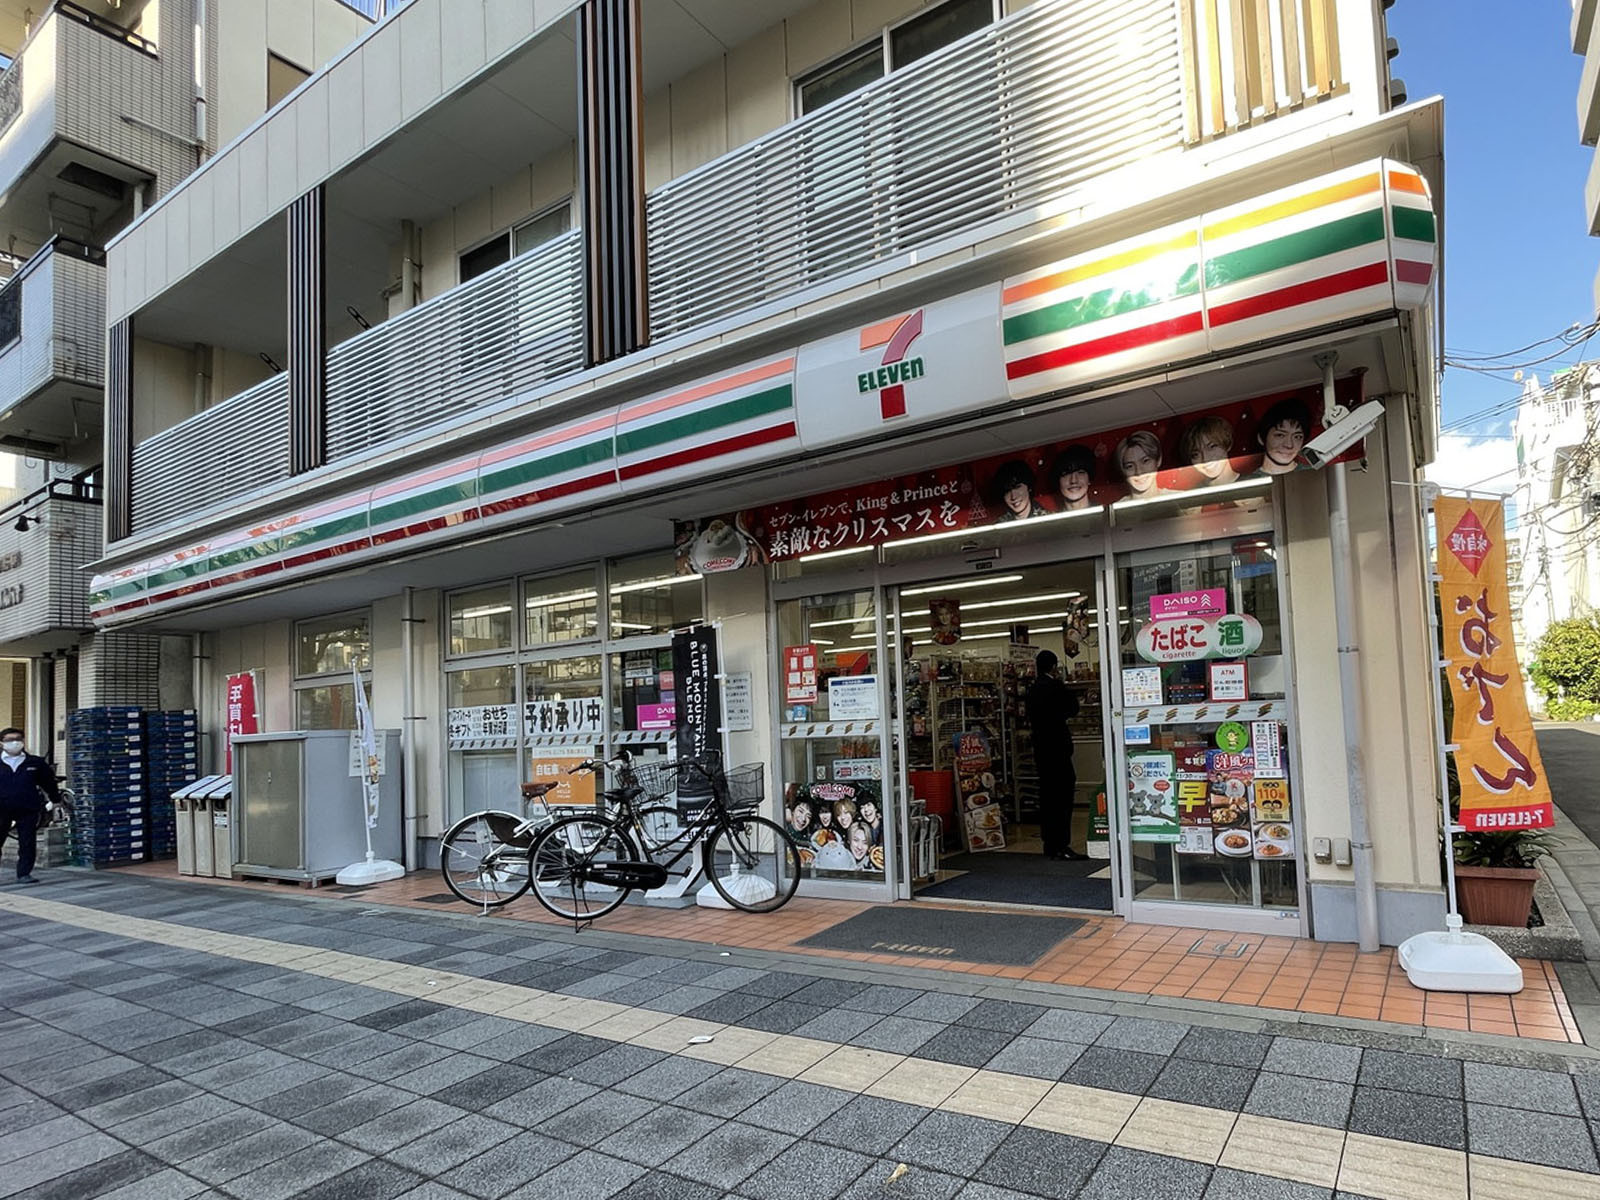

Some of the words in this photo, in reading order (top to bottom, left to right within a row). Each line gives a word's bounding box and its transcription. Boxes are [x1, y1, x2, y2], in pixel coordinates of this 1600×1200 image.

[856, 495, 888, 512] King
[890, 492, 900, 505] &
[769, 500, 961, 558] 素敵なクリスマスを
[1163, 595, 1198, 606] DAISO
[1150, 624, 1207, 652] たばこ
[1218, 620, 1244, 646] 酒
[690, 641, 700, 677] BLUE
[1162, 650, 1196, 659] cigarette
[1222, 647, 1246, 655] liquor
[1220, 668, 1236, 677] ATM
[686, 676, 694, 724] BLEND
[482, 706, 509, 721] おせち
[525, 699, 601, 734] 予約承り中
[692, 682, 703, 758] MOUNTAIN
